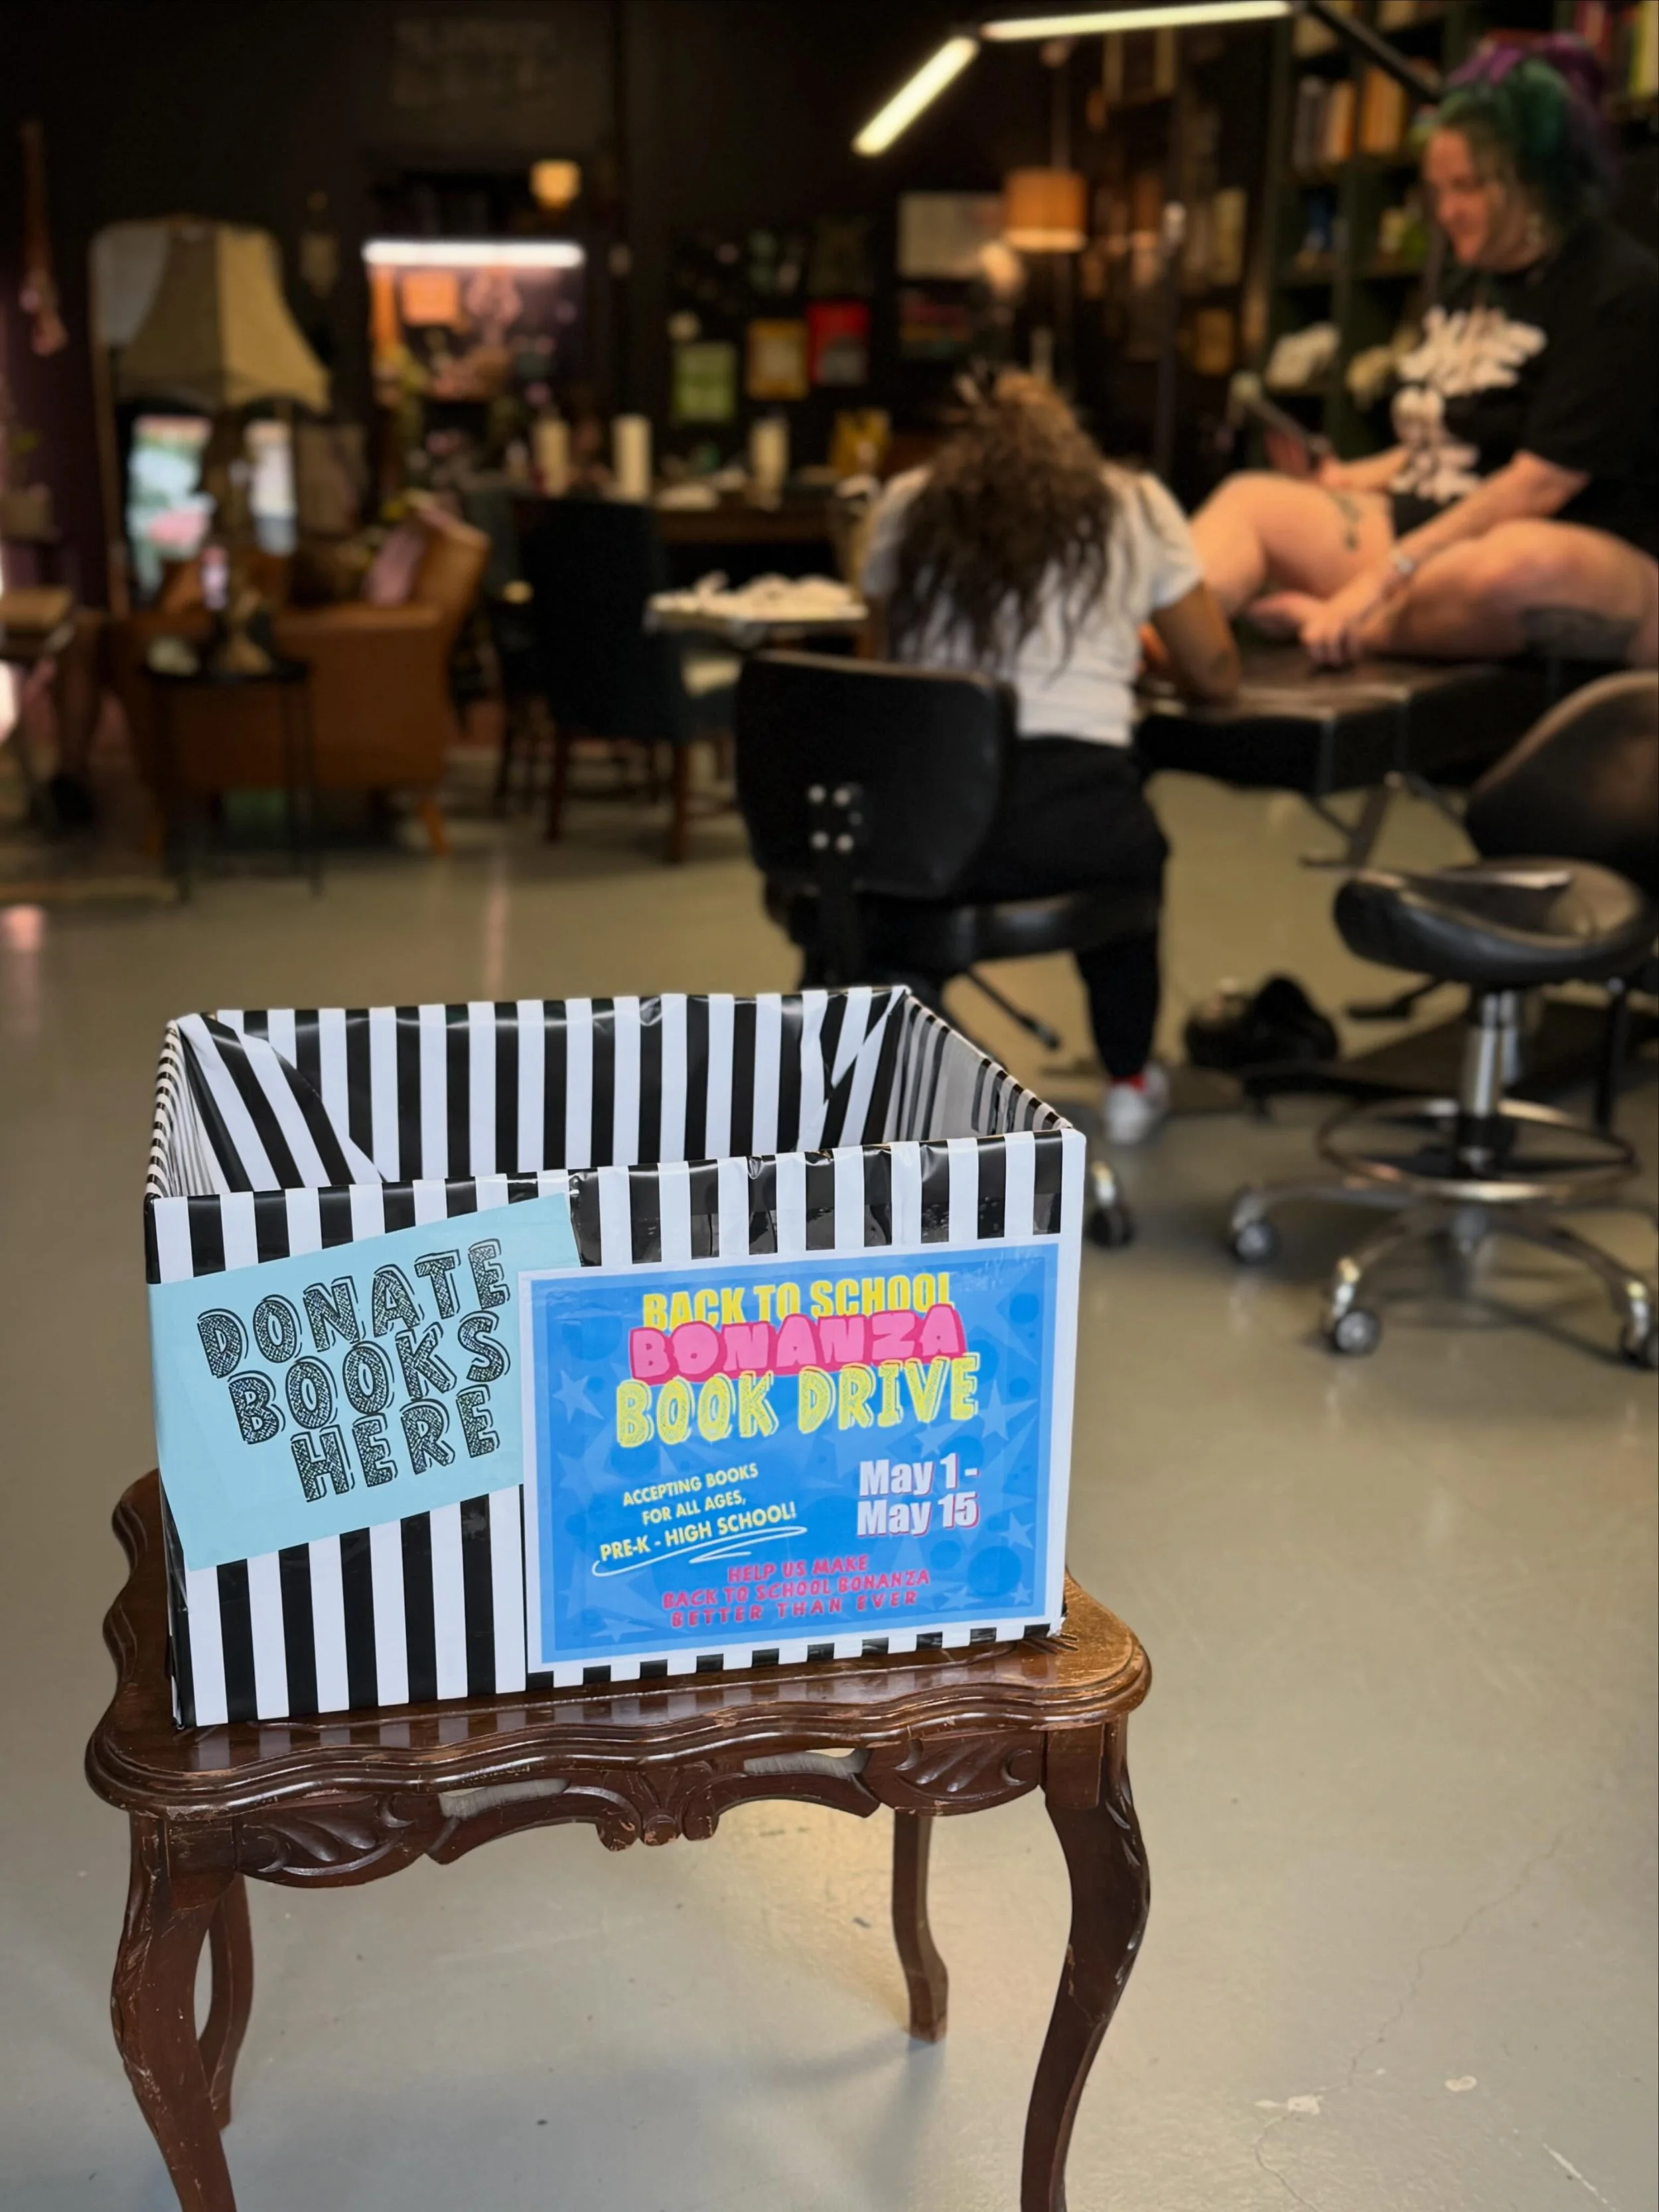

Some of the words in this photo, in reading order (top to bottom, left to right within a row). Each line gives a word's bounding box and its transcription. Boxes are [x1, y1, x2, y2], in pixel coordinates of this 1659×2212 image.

[198, 1238, 510, 1378] DONATE
[642, 1287, 747, 1331] BACK
[753, 1282, 801, 1324] TO
[809, 1272, 954, 1319] SCHOOL
[629, 1303, 968, 1386] BONANZA
[228, 1310, 510, 1445] BOOKS
[616, 1370, 779, 1447] BOOK
[798, 1352, 980, 1434] DRIVE
[291, 1384, 500, 1503] HERE
[622, 1476, 702, 1507] ACCEPTING
[705, 1462, 759, 1488] BOOKS
[859, 1458, 934, 1497] May
[940, 1452, 958, 1489] 1
[600, 1534, 650, 1562] PRE-K
[664, 1520, 712, 1547] HIGH
[717, 1501, 797, 1535] SCHOOL!
[642, 1506, 672, 1526] FOR
[676, 1499, 701, 1518] ALL
[705, 1489, 747, 1512] AGES,
[857, 1499, 932, 1537] May
[938, 1491, 979, 1529] 15
[662, 1588, 718, 1609] BACK
[723, 1584, 748, 1603] TO
[755, 1578, 832, 1601] SCHOOL
[837, 1569, 930, 1593] BONANZA
[727, 1563, 776, 1584] HELP
[782, 1560, 806, 1578] US
[812, 1554, 870, 1576] MAKE
[670, 1605, 763, 1629] BETTER
[777, 1597, 842, 1619] THAN
[857, 1591, 918, 1611] EVER
